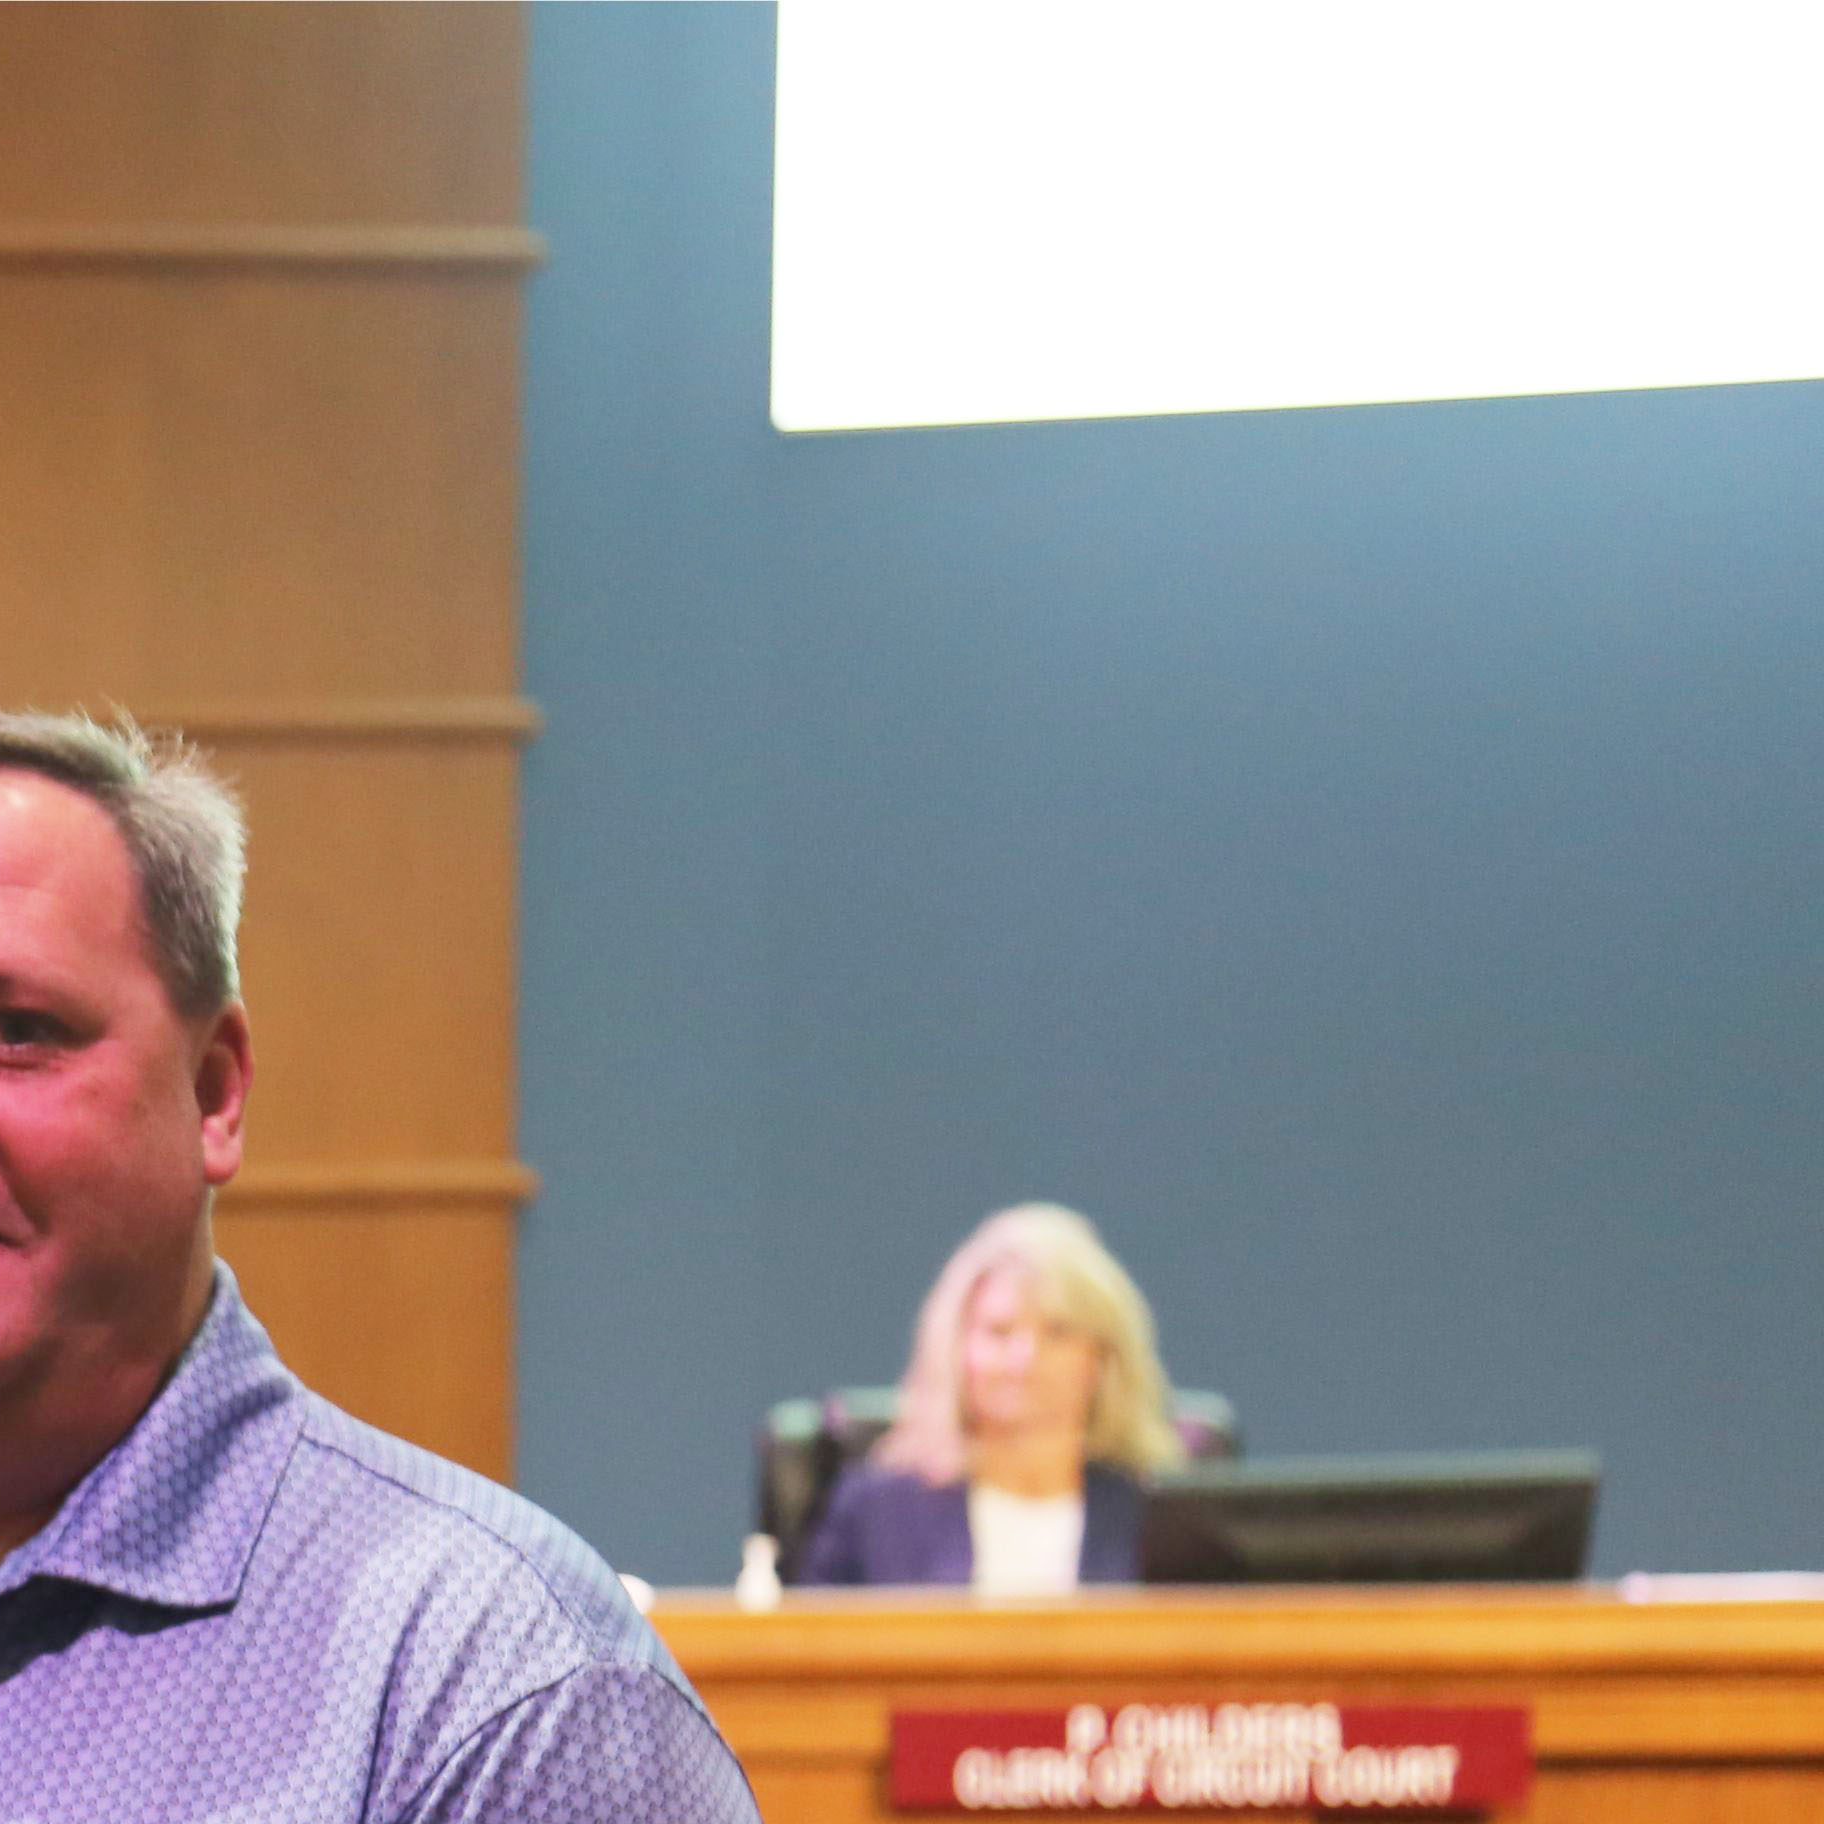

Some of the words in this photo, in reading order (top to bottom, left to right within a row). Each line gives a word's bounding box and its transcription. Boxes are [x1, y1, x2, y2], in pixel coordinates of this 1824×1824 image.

[1089, 1746, 1153, 1808] OF
[1154, 1745, 1311, 1808] CIRCUIT
[1312, 1745, 1460, 1807] COURT
